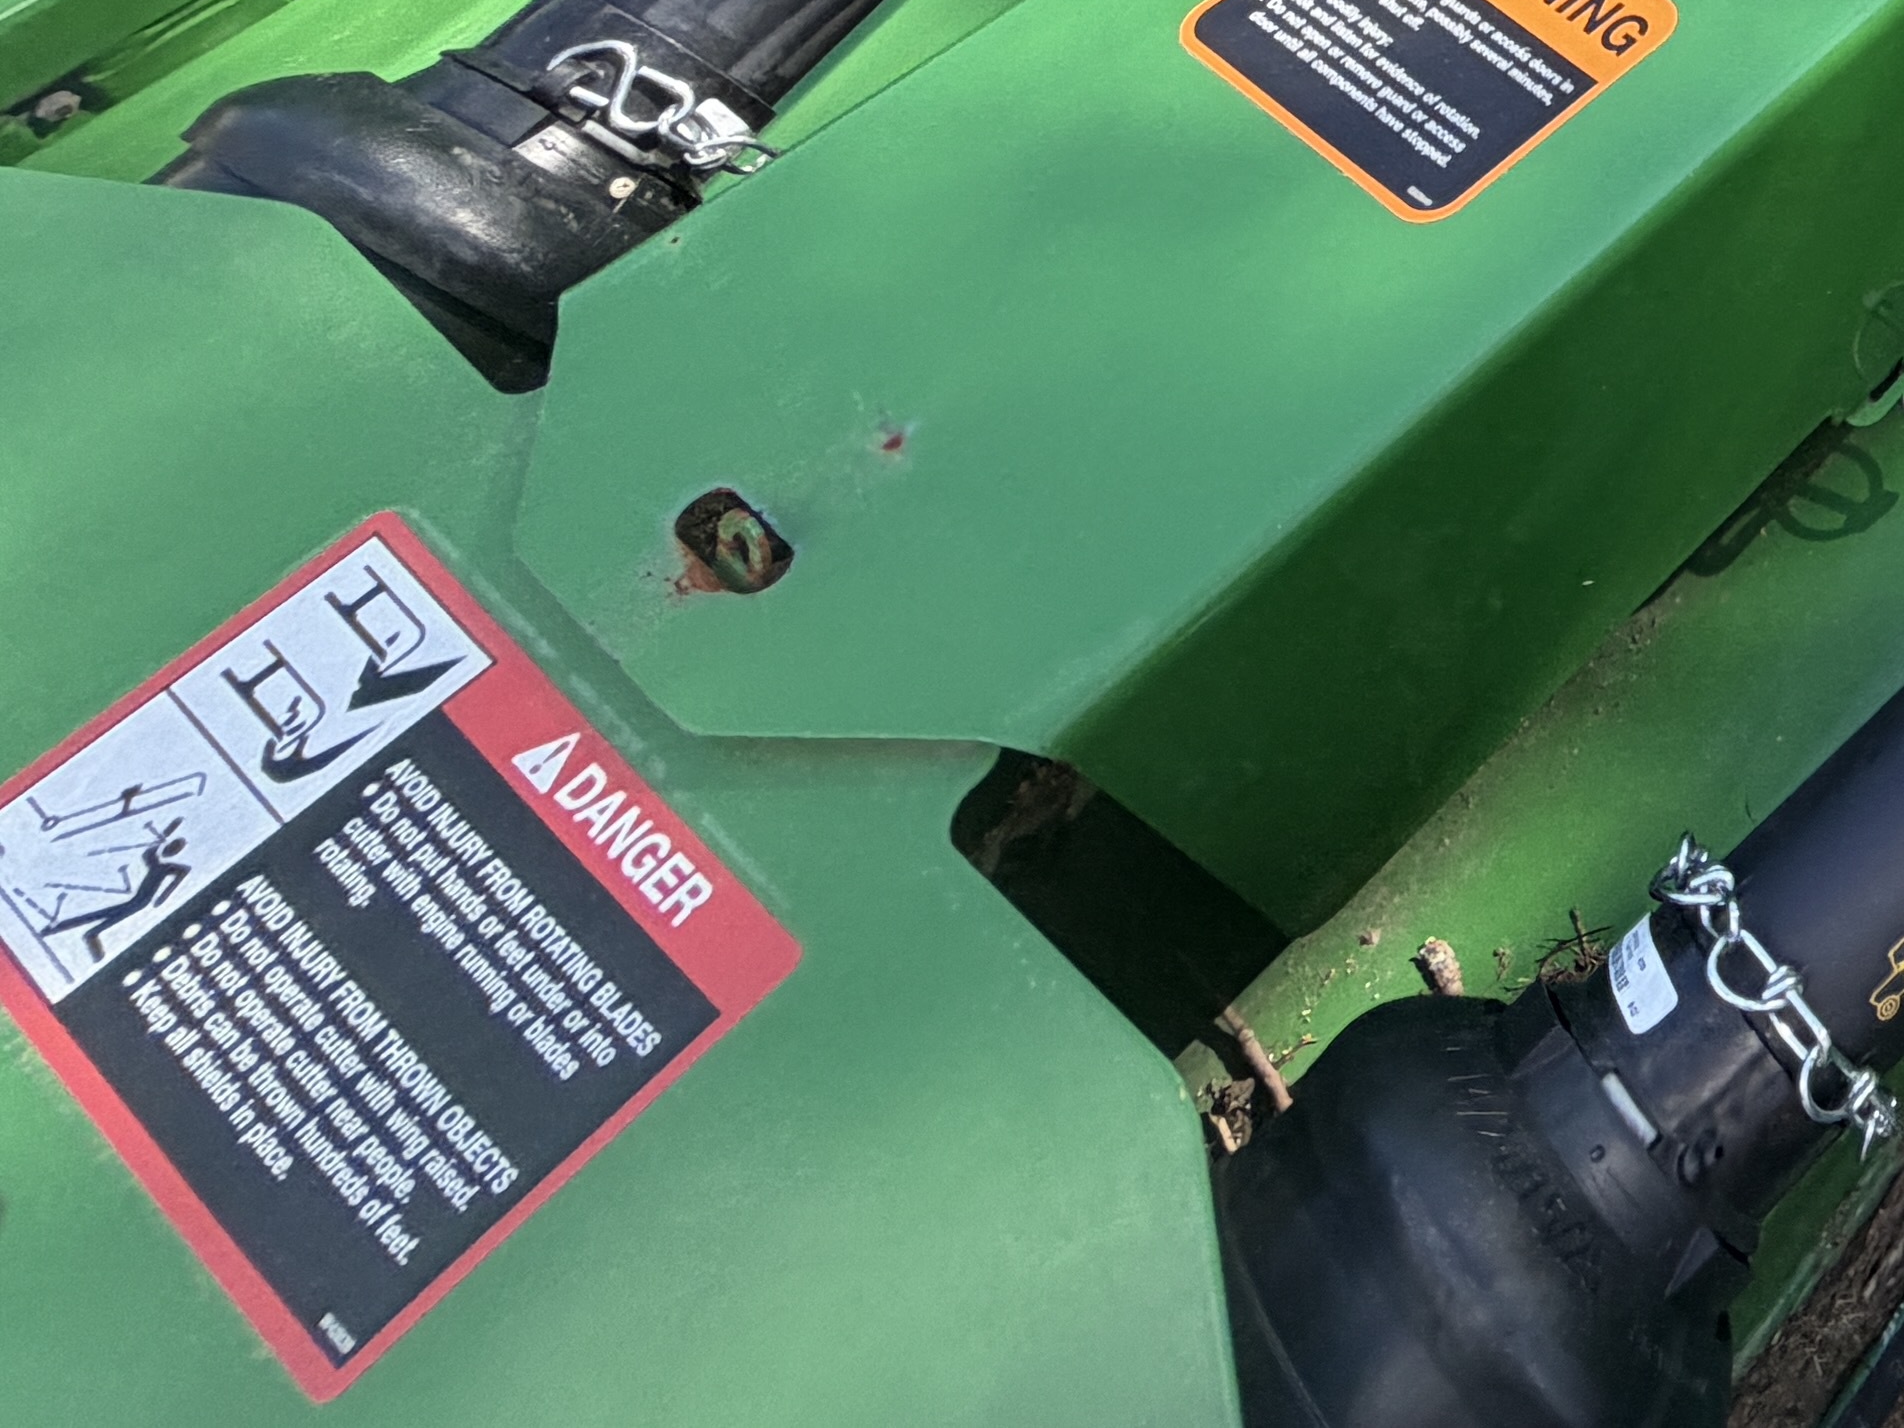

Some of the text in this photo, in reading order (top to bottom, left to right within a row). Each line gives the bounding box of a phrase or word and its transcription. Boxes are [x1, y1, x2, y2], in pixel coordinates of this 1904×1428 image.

[1247, 10, 1452, 168] door until all components have stopped.
[1281, 10, 1307, 29] not
[1300, 24, 1332, 50] open
[1326, 45, 1345, 59] or
[1339, 54, 1383, 89] remove
[1375, 85, 1417, 113] guard
[1410, 109, 1429, 123] or
[1423, 119, 1466, 153] access
[1309, 5, 1338, 26] and
[1329, 19, 1363, 48] listen
[1358, 41, 1380, 60] for
[1374, 56, 1425, 96] evidence
[1421, 92, 1442, 105] of
[1433, 100, 1480, 140] rotation.
[1356, 15, 1394, 47] injury:
[1401, 13, 1425, 31] off.
[1423, 6, 1474, 44] possibly
[1468, 38, 1514, 71] several
[1506, 66, 1553, 106] minutes,
[1477, 20, 1495, 34] or
[1489, 30, 1531, 62] access
[1527, 57, 1563, 85] doors
[1558, 78, 1574, 94] in
[313, 837, 376, 907] rotating.
[384, 758, 662, 1056] AVOID INJURY FROM ROTATING BLADES
[552, 762, 713, 927] DANGER
[342, 816, 579, 1080] cutter with engine running or blades
[369, 789, 616, 1067] Do not put hands or feet under or into
[129, 977, 293, 1180] Keep all shields in place.
[160, 954, 419, 1265] Debris can be thrown hundreds of feet.
[189, 931, 415, 1204] Do not operate cutter near people.
[219, 907, 480, 1212] Do not operate cutter with wing raised.
[235, 874, 519, 1194] AVOID INJURY FROM THROWN OBJECTS
